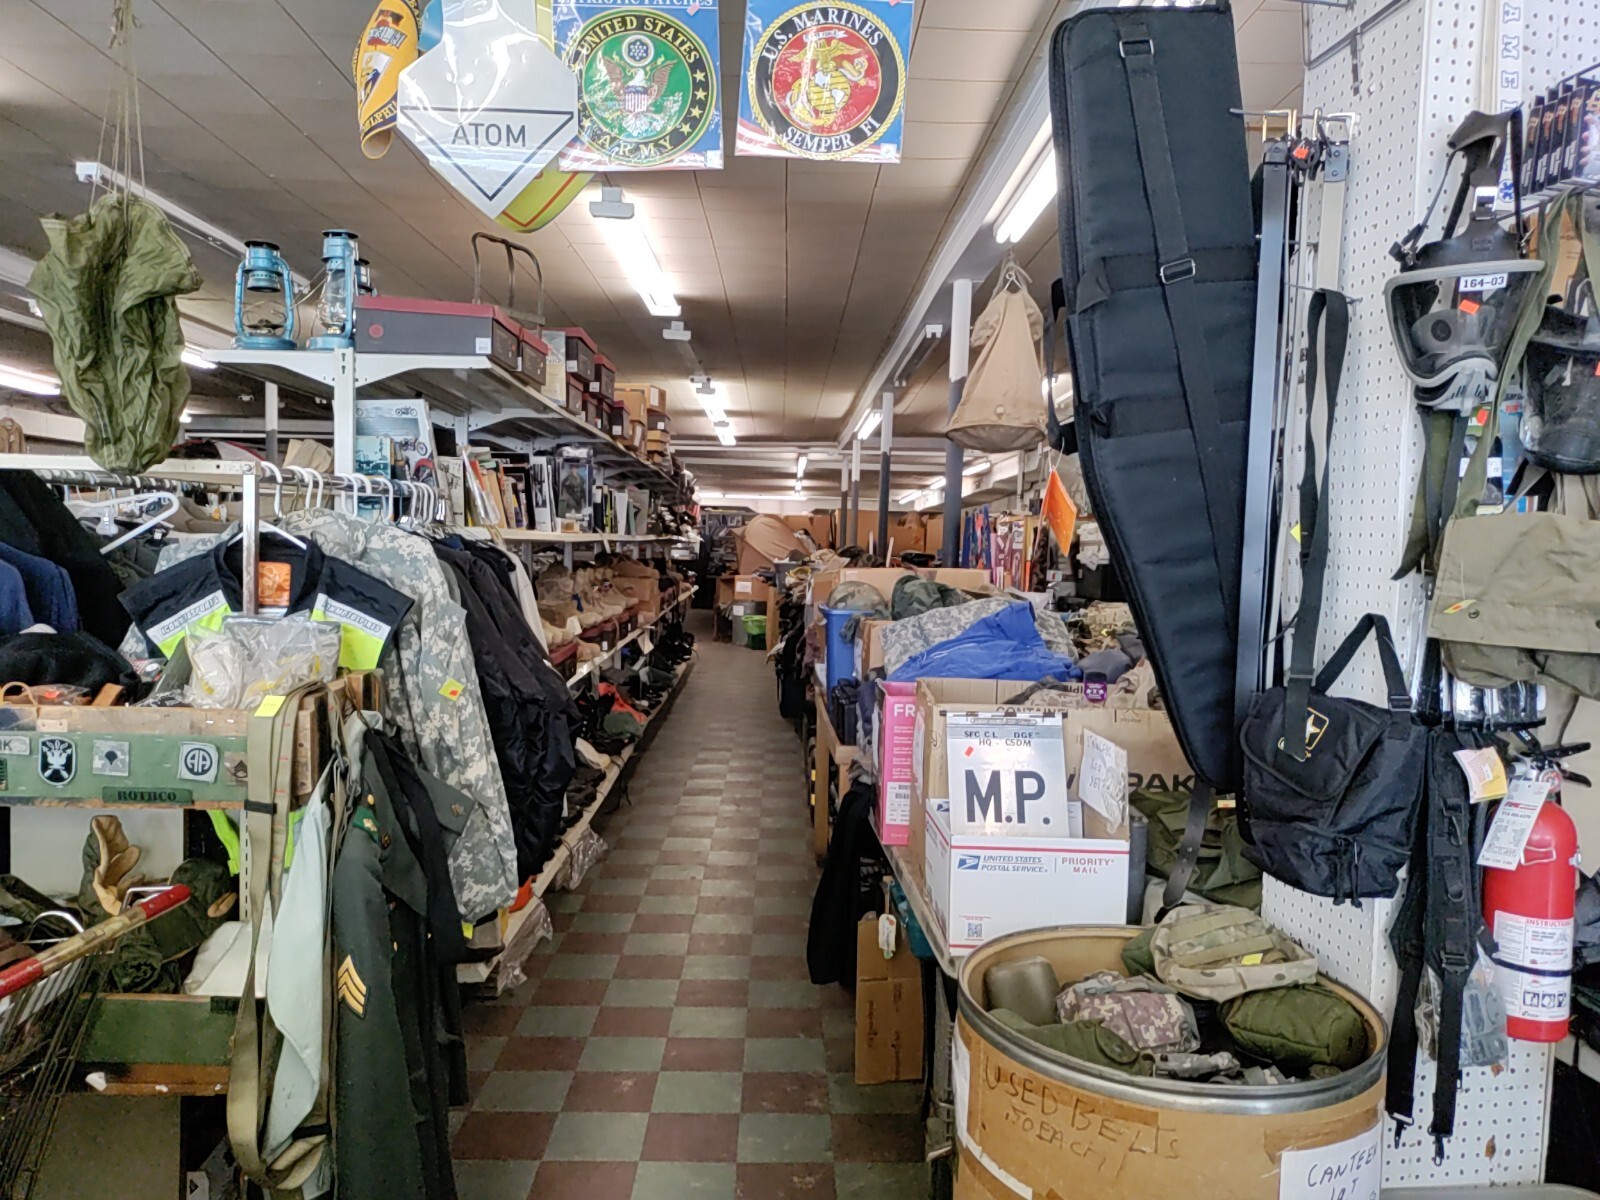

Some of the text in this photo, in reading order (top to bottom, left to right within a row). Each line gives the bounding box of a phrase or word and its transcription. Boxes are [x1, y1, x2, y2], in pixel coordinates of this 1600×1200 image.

[578, 16, 700, 63] UNITED STATES
[762, 8, 884, 60] U.S. MARINES
[451, 123, 526, 147] ATOM
[598, 135, 674, 158] ARMY
[783, 115, 881, 153] SEMPER FI
[1463, 276, 1505, 288] 164-03
[979, 738, 992, 747] HQ
[185, 748, 212, 775] AA
[117, 790, 177, 801] ROTHCO
[965, 769, 1051, 825] M.P.
[981, 864, 1010, 872] POSTAL
[983, 855, 1042, 864] UNITED STATES
[984, 1055, 1182, 1161] USED BELTS
[1308, 1142, 1378, 1188] CANTEEN
